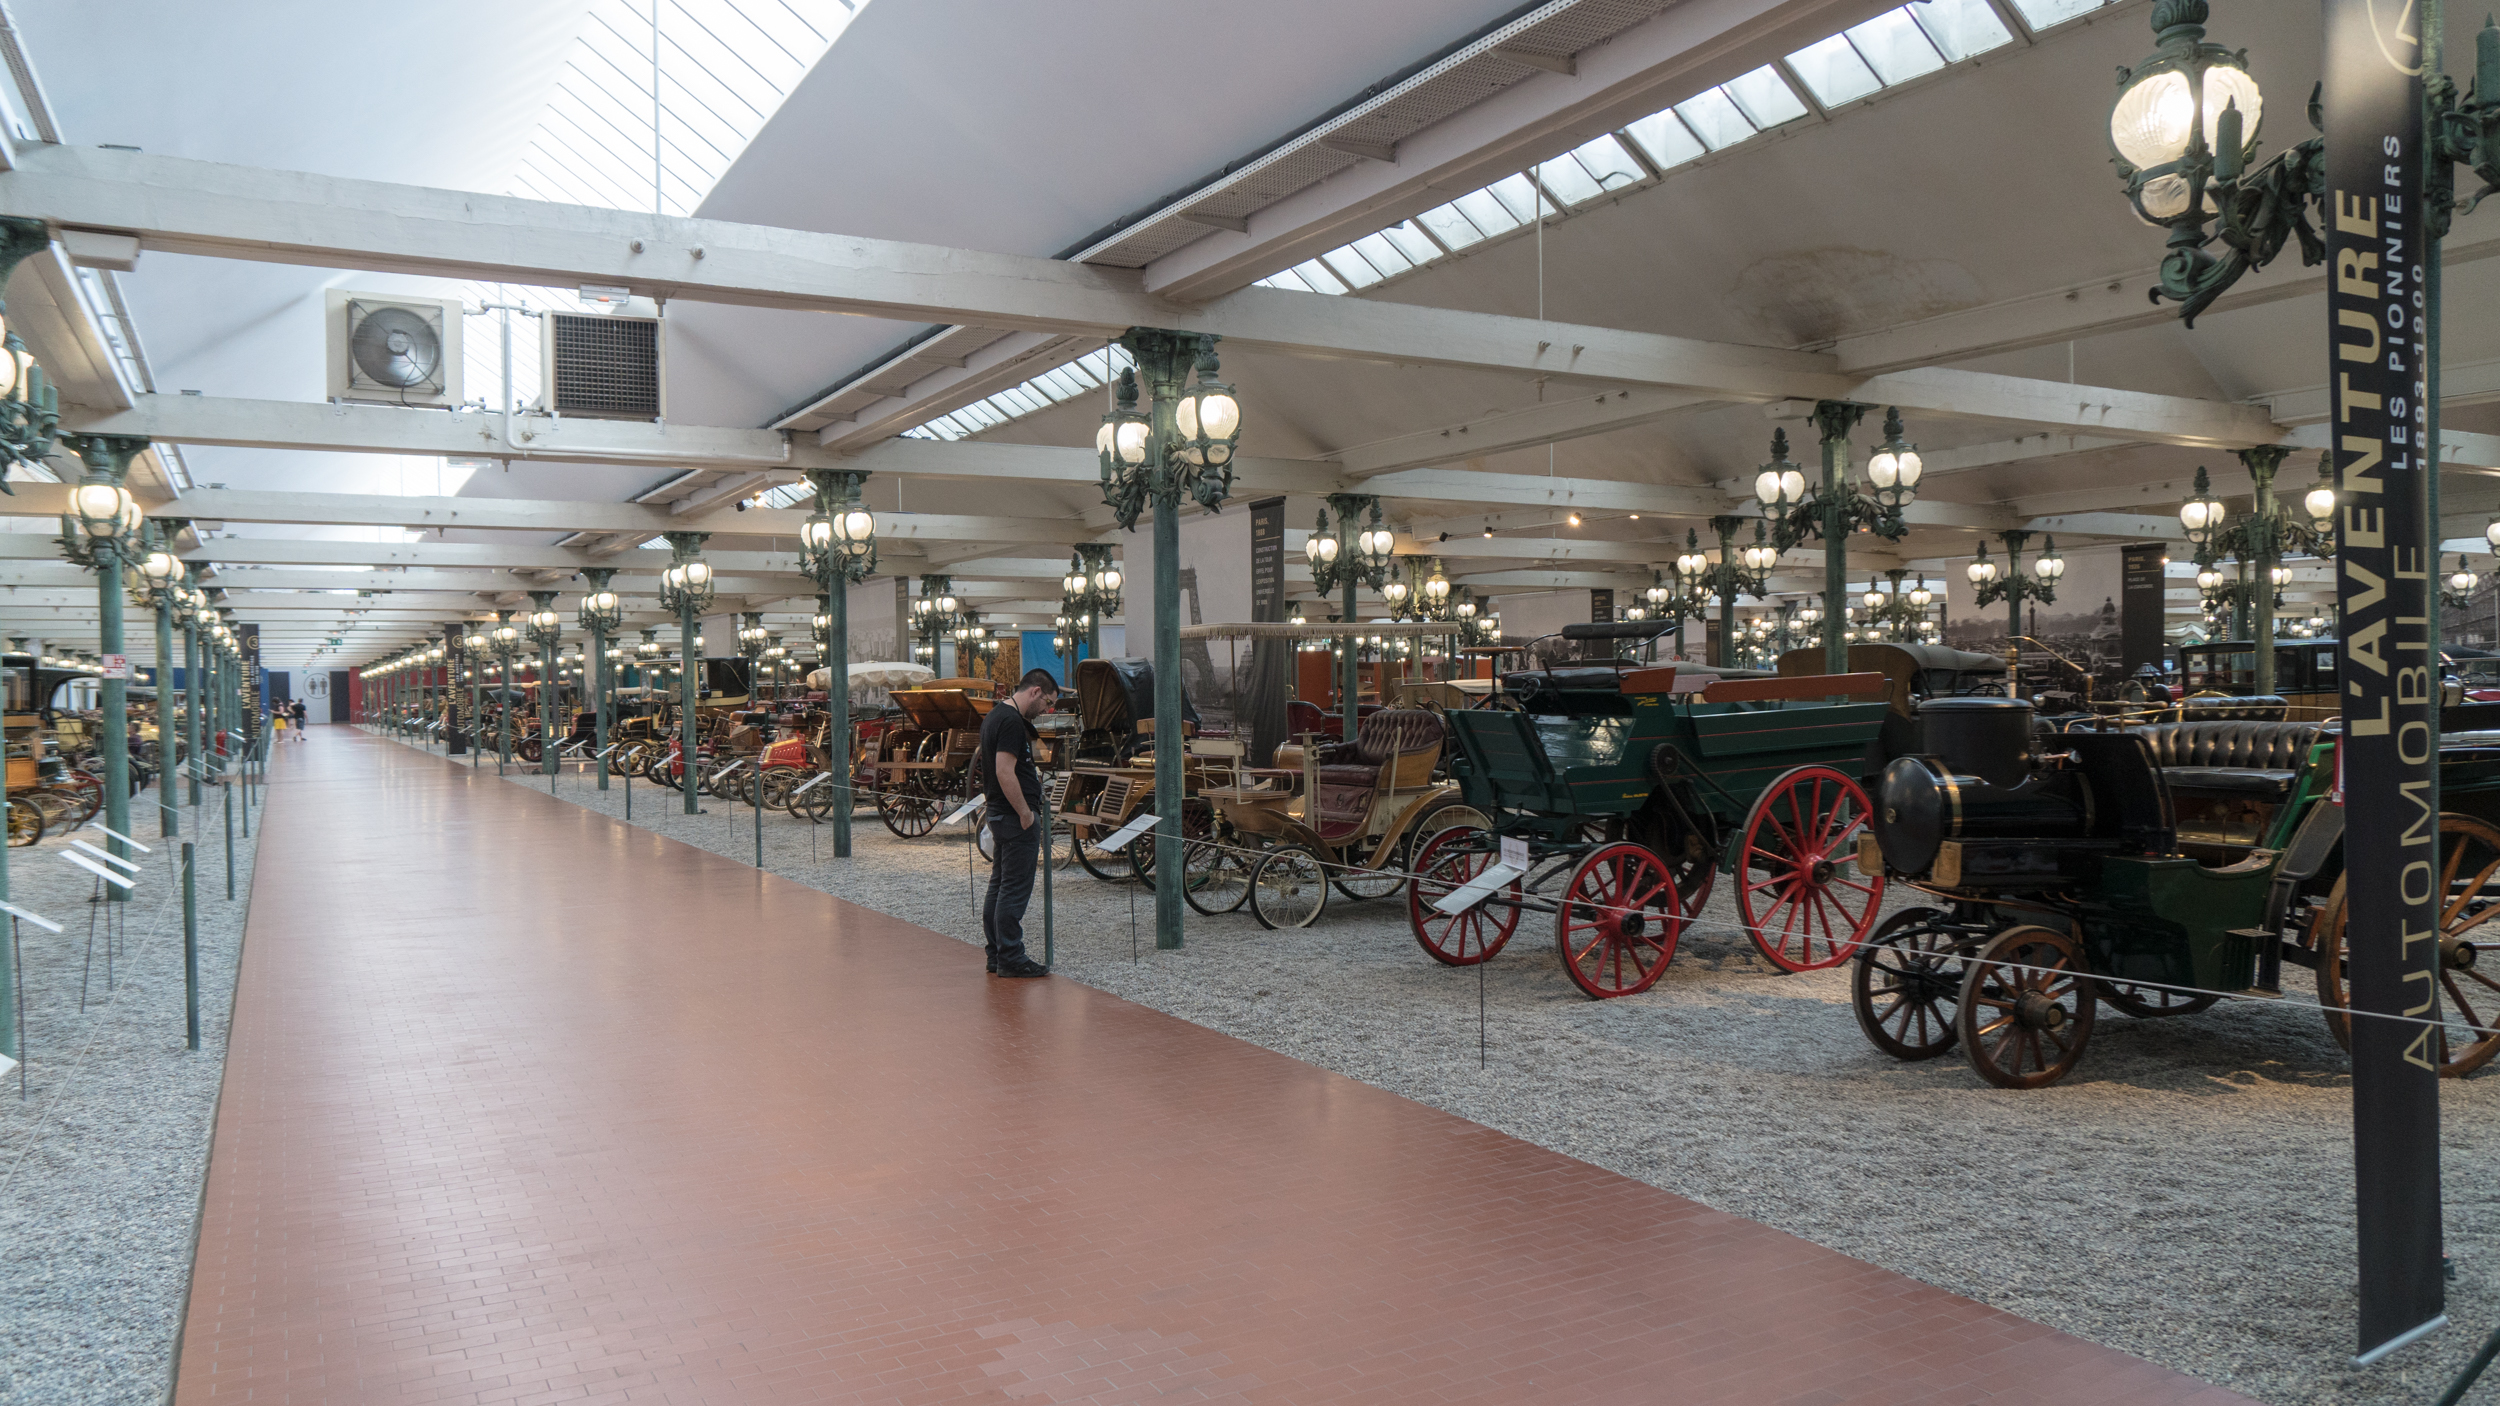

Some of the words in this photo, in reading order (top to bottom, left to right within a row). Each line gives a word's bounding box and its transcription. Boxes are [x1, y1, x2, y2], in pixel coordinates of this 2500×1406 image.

[2384, 134, 2406, 371] PIONNIERS
[2335, 189, 2390, 737] L'AVENTURE
[2390, 396, 2408, 470] LES
[241, 660, 251, 709] L'AVENTURE
[447, 658, 456, 705] L'AVENTURE
[2395, 544, 2434, 1072] AUTOMOBILE
